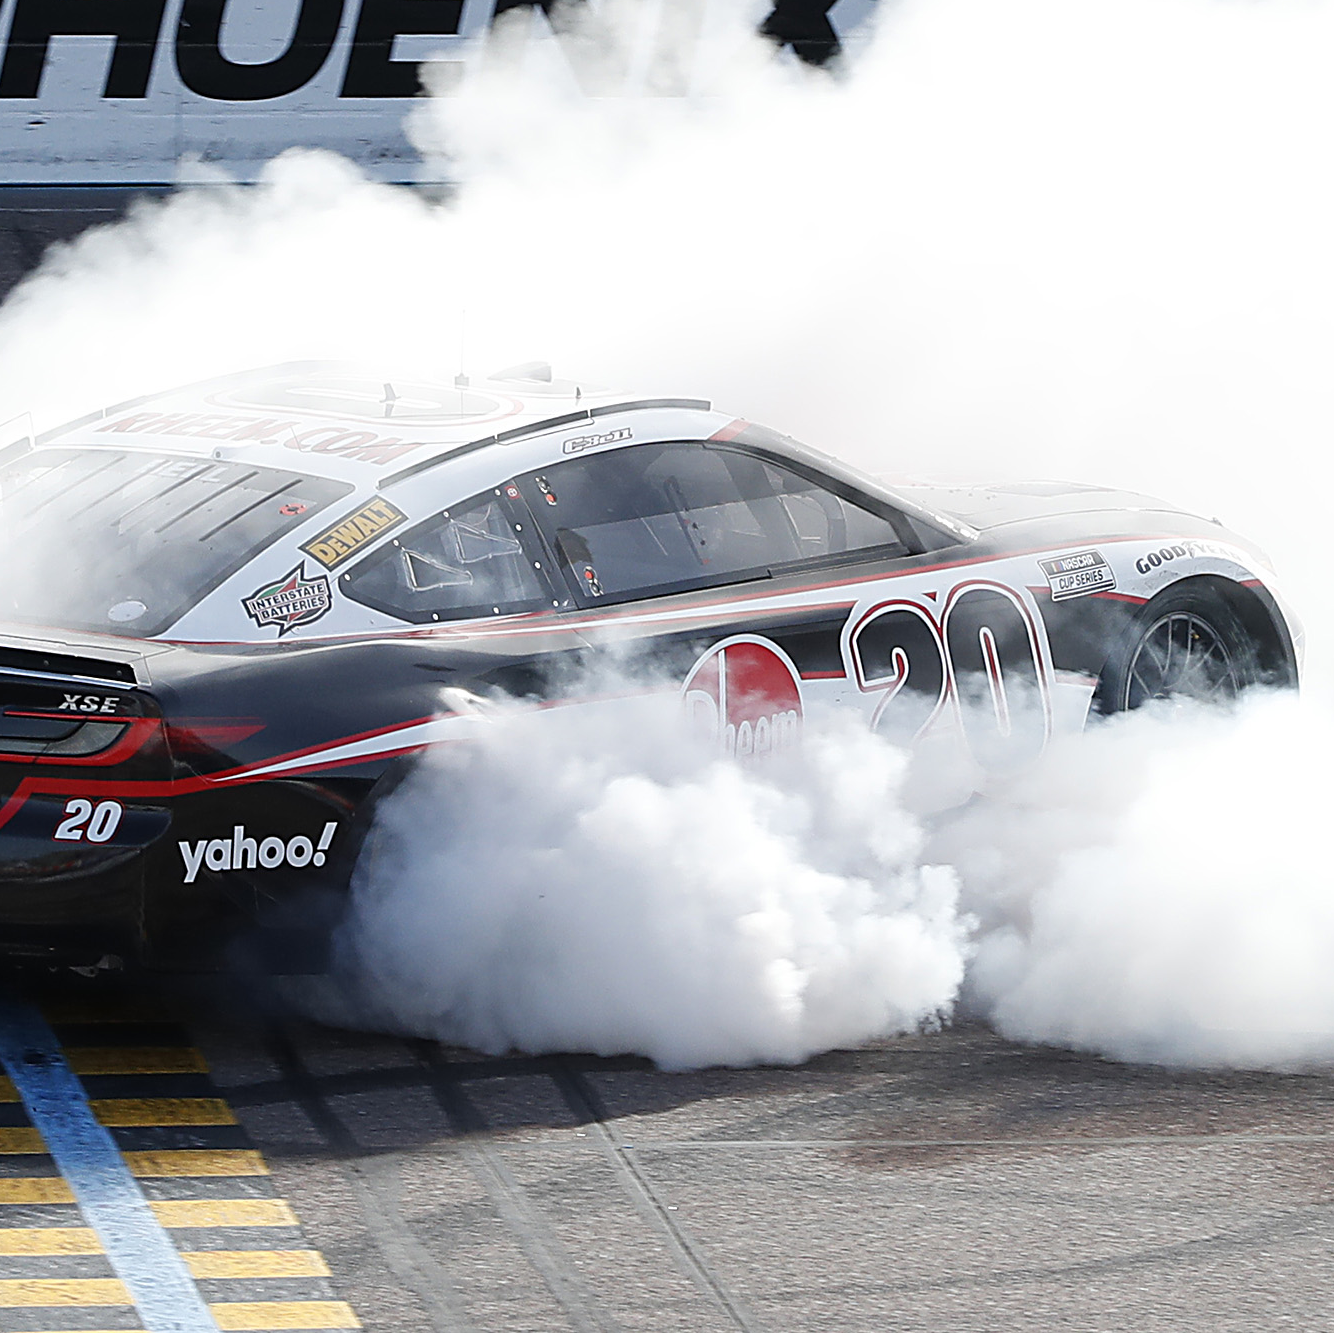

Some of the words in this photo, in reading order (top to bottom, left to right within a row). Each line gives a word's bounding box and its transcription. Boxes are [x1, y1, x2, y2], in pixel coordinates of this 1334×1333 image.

[92, 412, 426, 467] RHEEM.COM
[1060, 552, 1096, 572] NASCAR
[1058, 575, 1076, 590] CUP
[1075, 569, 1104, 587] SERIES
[250, 583, 325, 612] INTERSTATE
[259, 594, 327, 621] BATTERIES
[58, 693, 120, 714] XSE
[53, 798, 123, 843] 20
[178, 821, 338, 883] yahoo!
